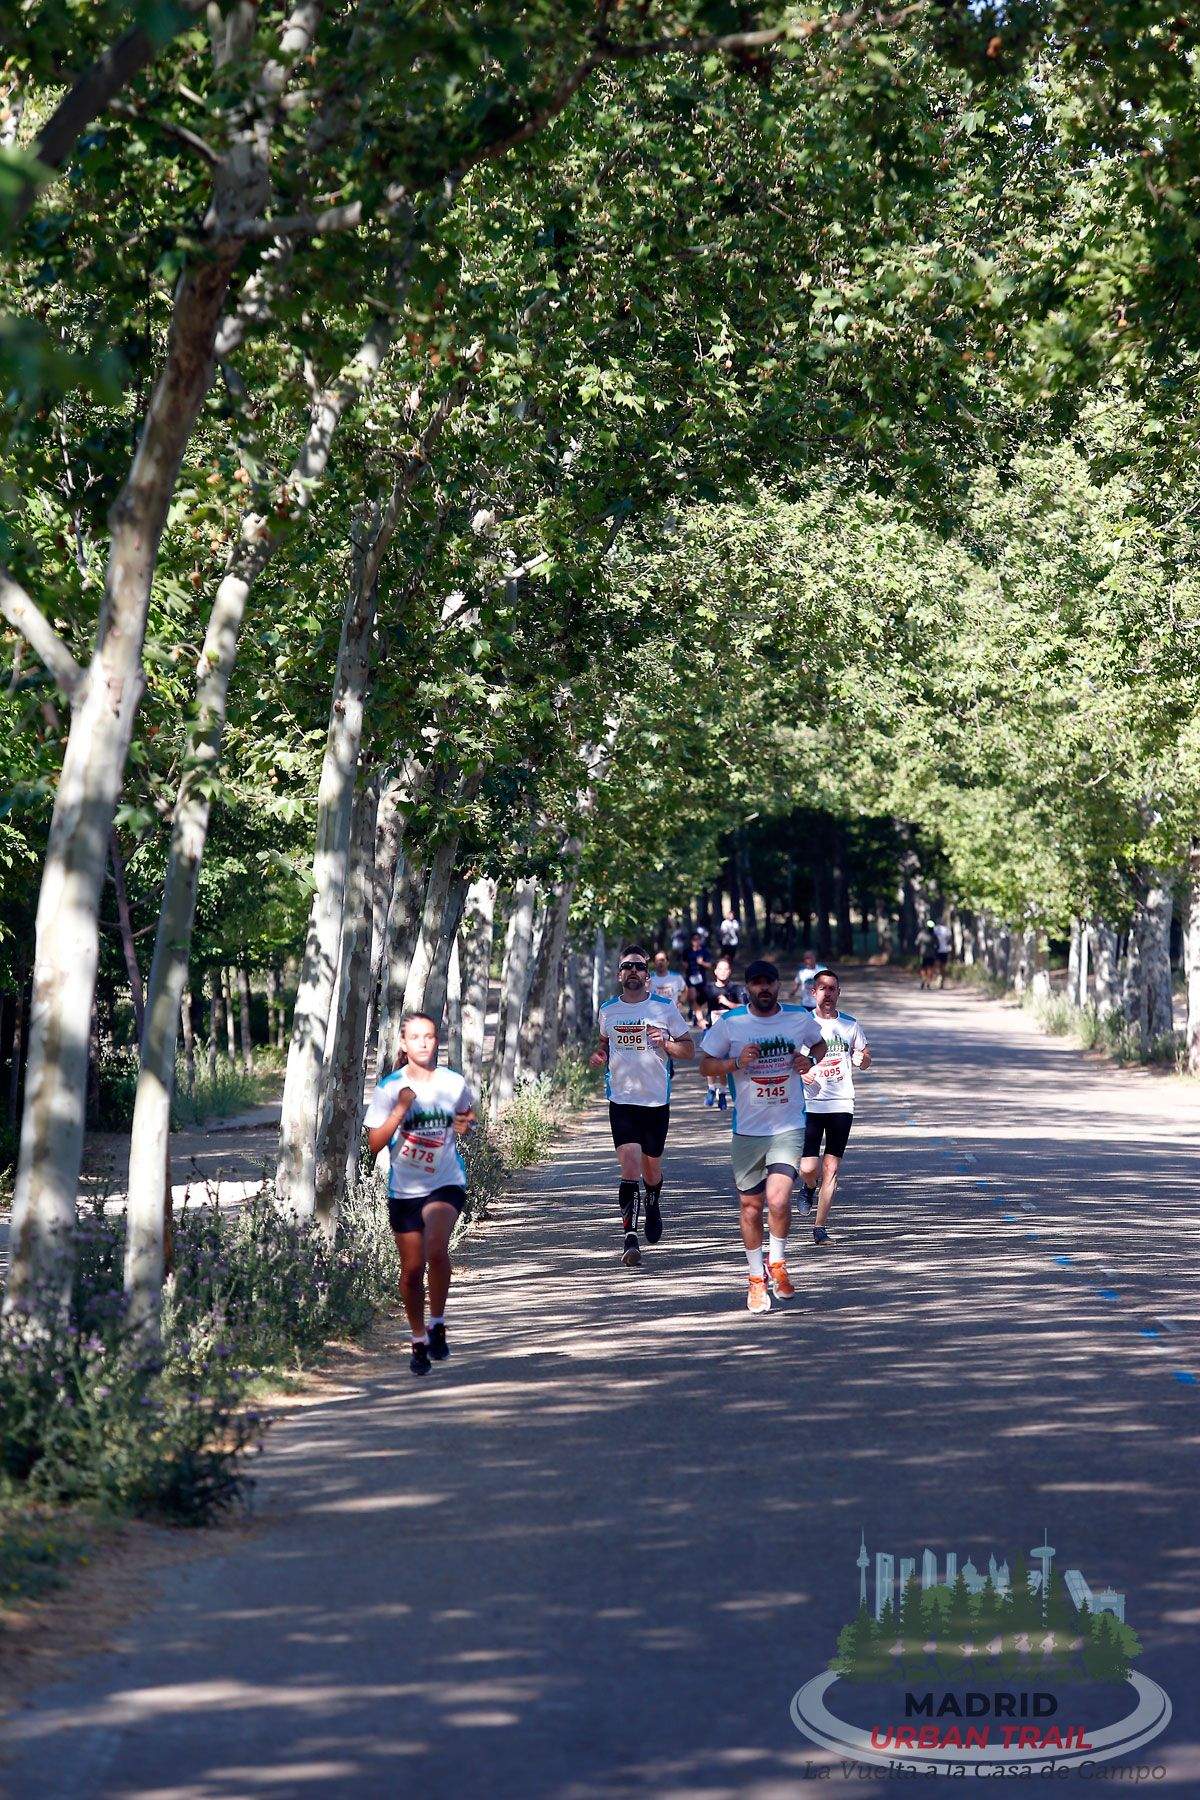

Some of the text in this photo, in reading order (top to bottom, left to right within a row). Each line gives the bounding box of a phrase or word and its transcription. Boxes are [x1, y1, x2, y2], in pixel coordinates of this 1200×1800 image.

[617, 1035, 642, 1044] 2096
[819, 1067, 841, 1078] 2095
[756, 1086, 786, 1098] 2145
[402, 1145, 434, 1163] 2178
